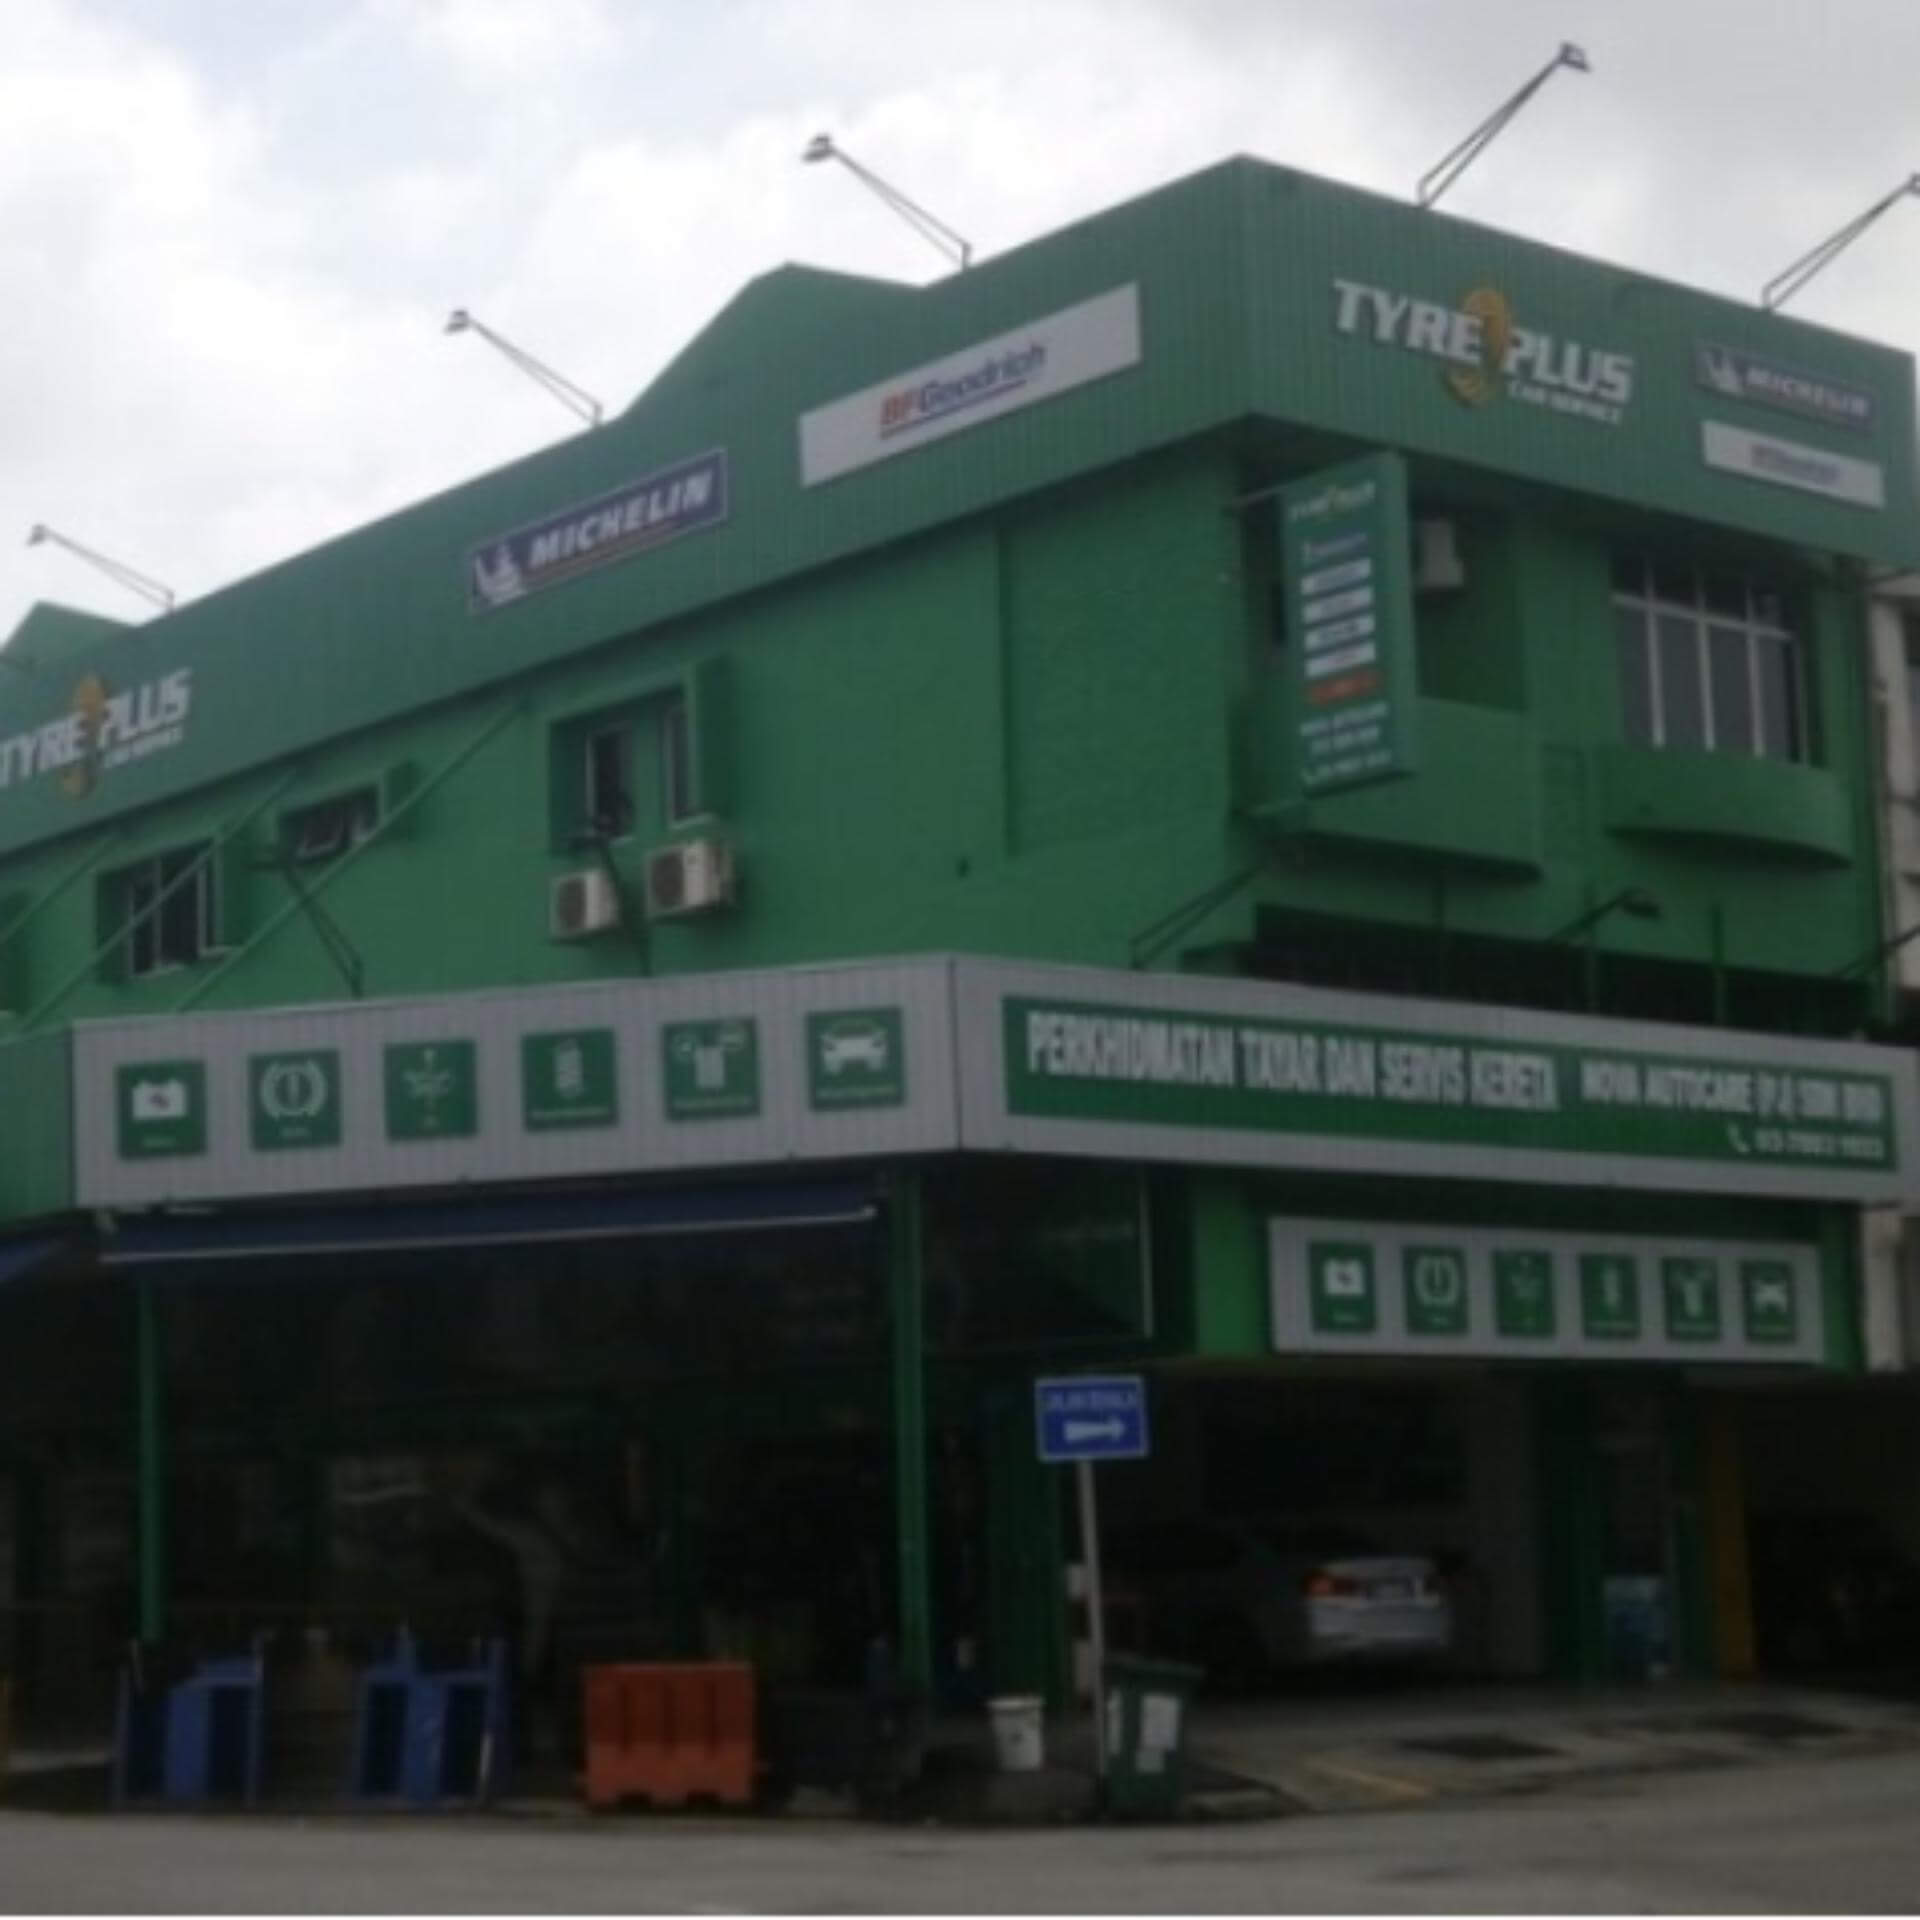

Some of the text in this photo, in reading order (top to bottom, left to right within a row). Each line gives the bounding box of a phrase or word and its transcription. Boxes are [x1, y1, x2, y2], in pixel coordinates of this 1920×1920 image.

[878, 341, 1047, 427] BFGoodrich
[1333, 279, 1634, 404] TYRE PLUS
[528, 469, 715, 570] MICHELIN
[97, 666, 192, 749] PLUS
[1381, 1042, 1465, 1105] SERVIS
